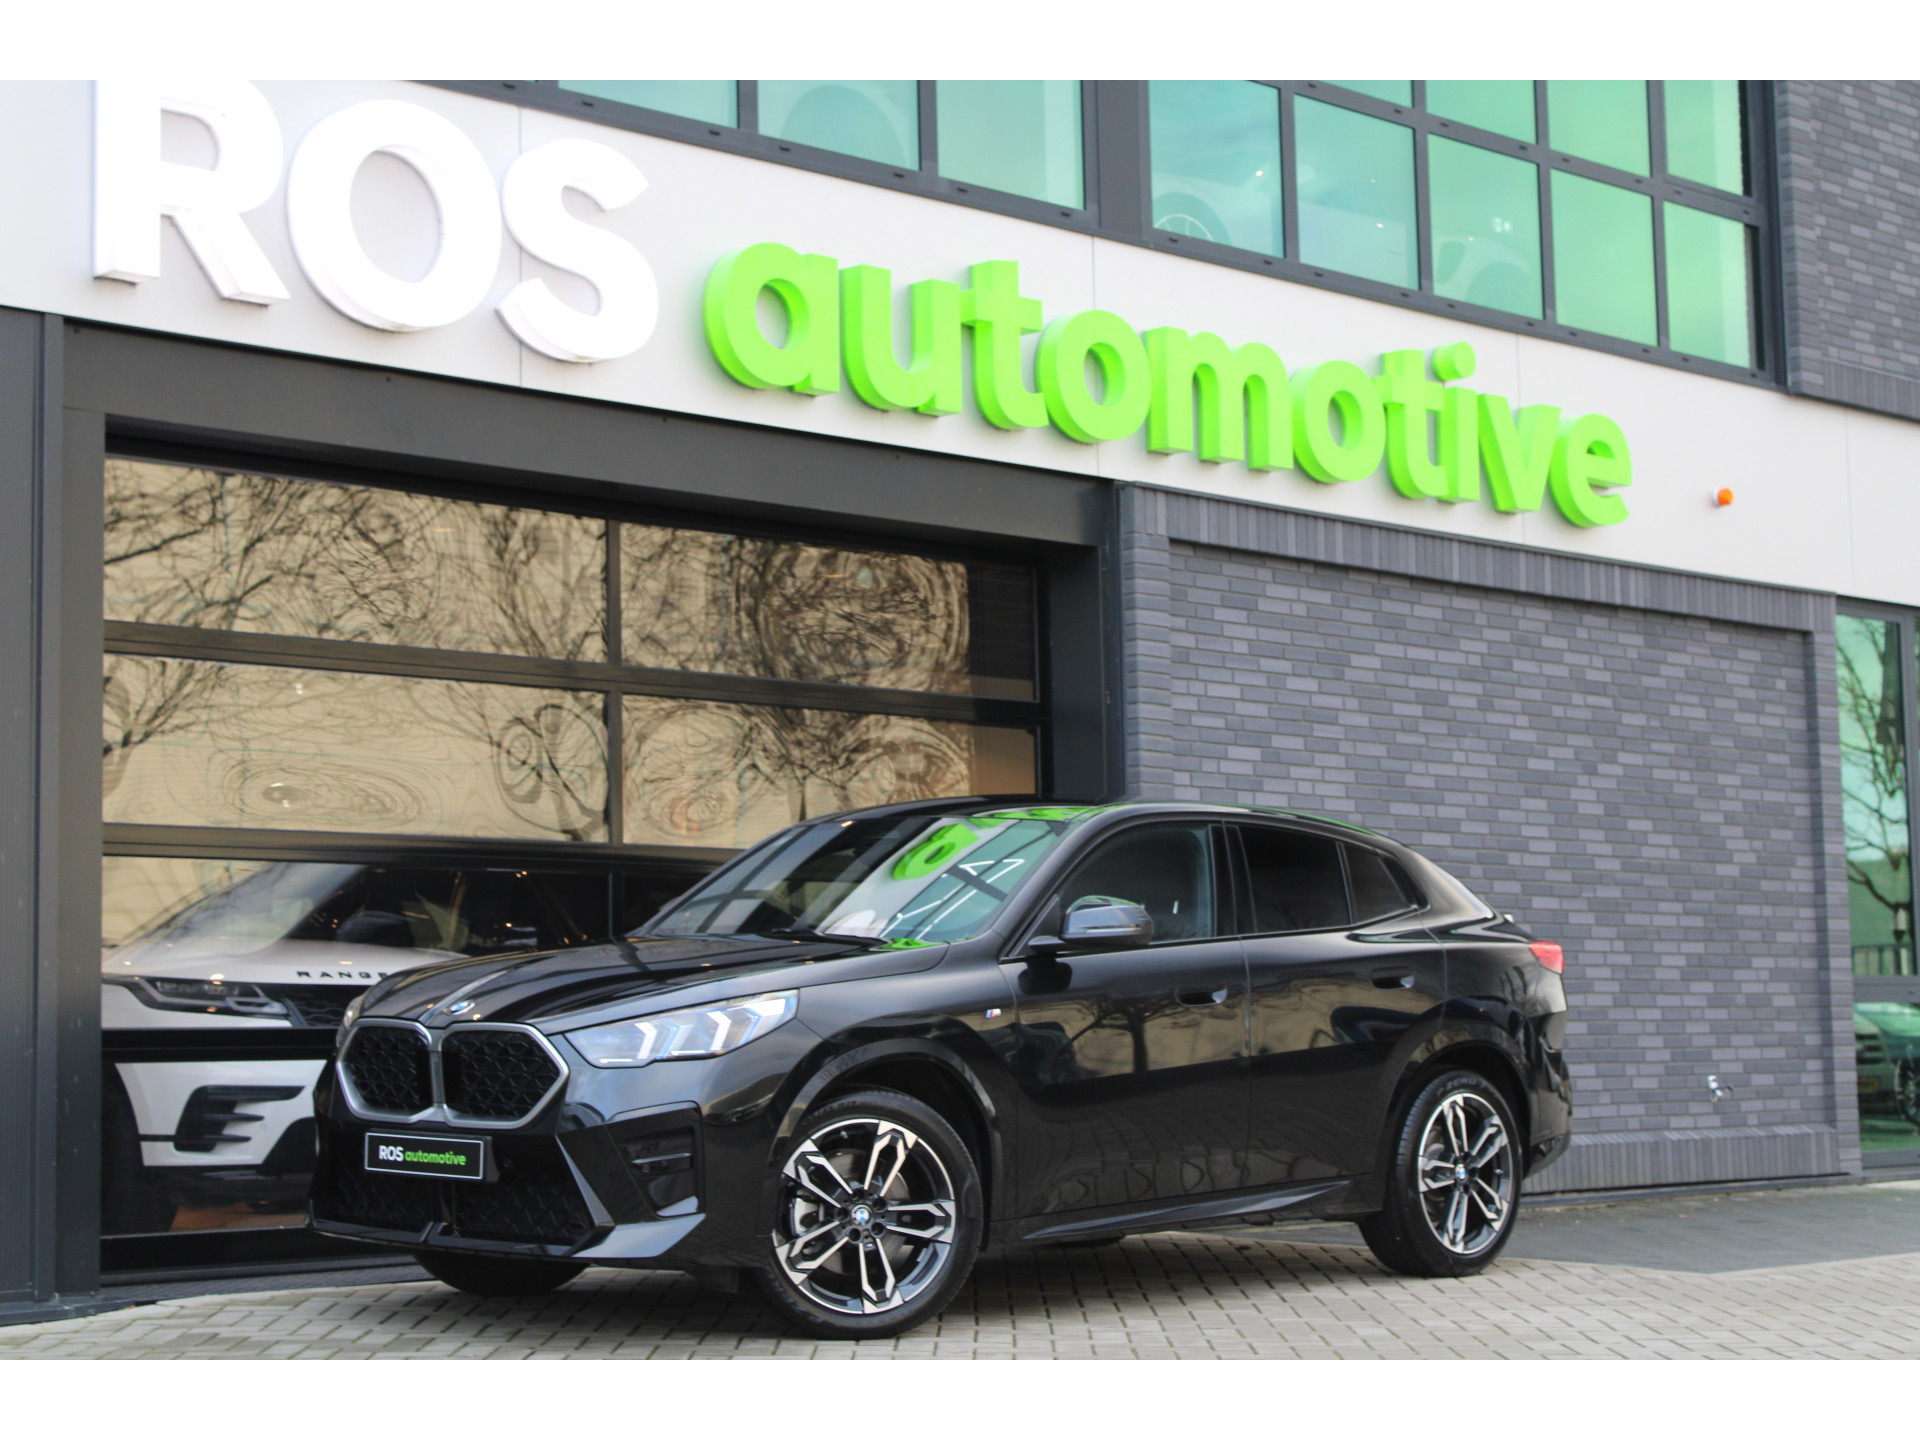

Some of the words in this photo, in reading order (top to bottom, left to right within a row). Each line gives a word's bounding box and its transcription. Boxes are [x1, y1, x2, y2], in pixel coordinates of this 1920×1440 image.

[93, 81, 660, 363] ROS
[702, 243, 1632, 527] automotive
[379, 1145, 404, 1162] ROS
[404, 1150, 467, 1166] automotive
